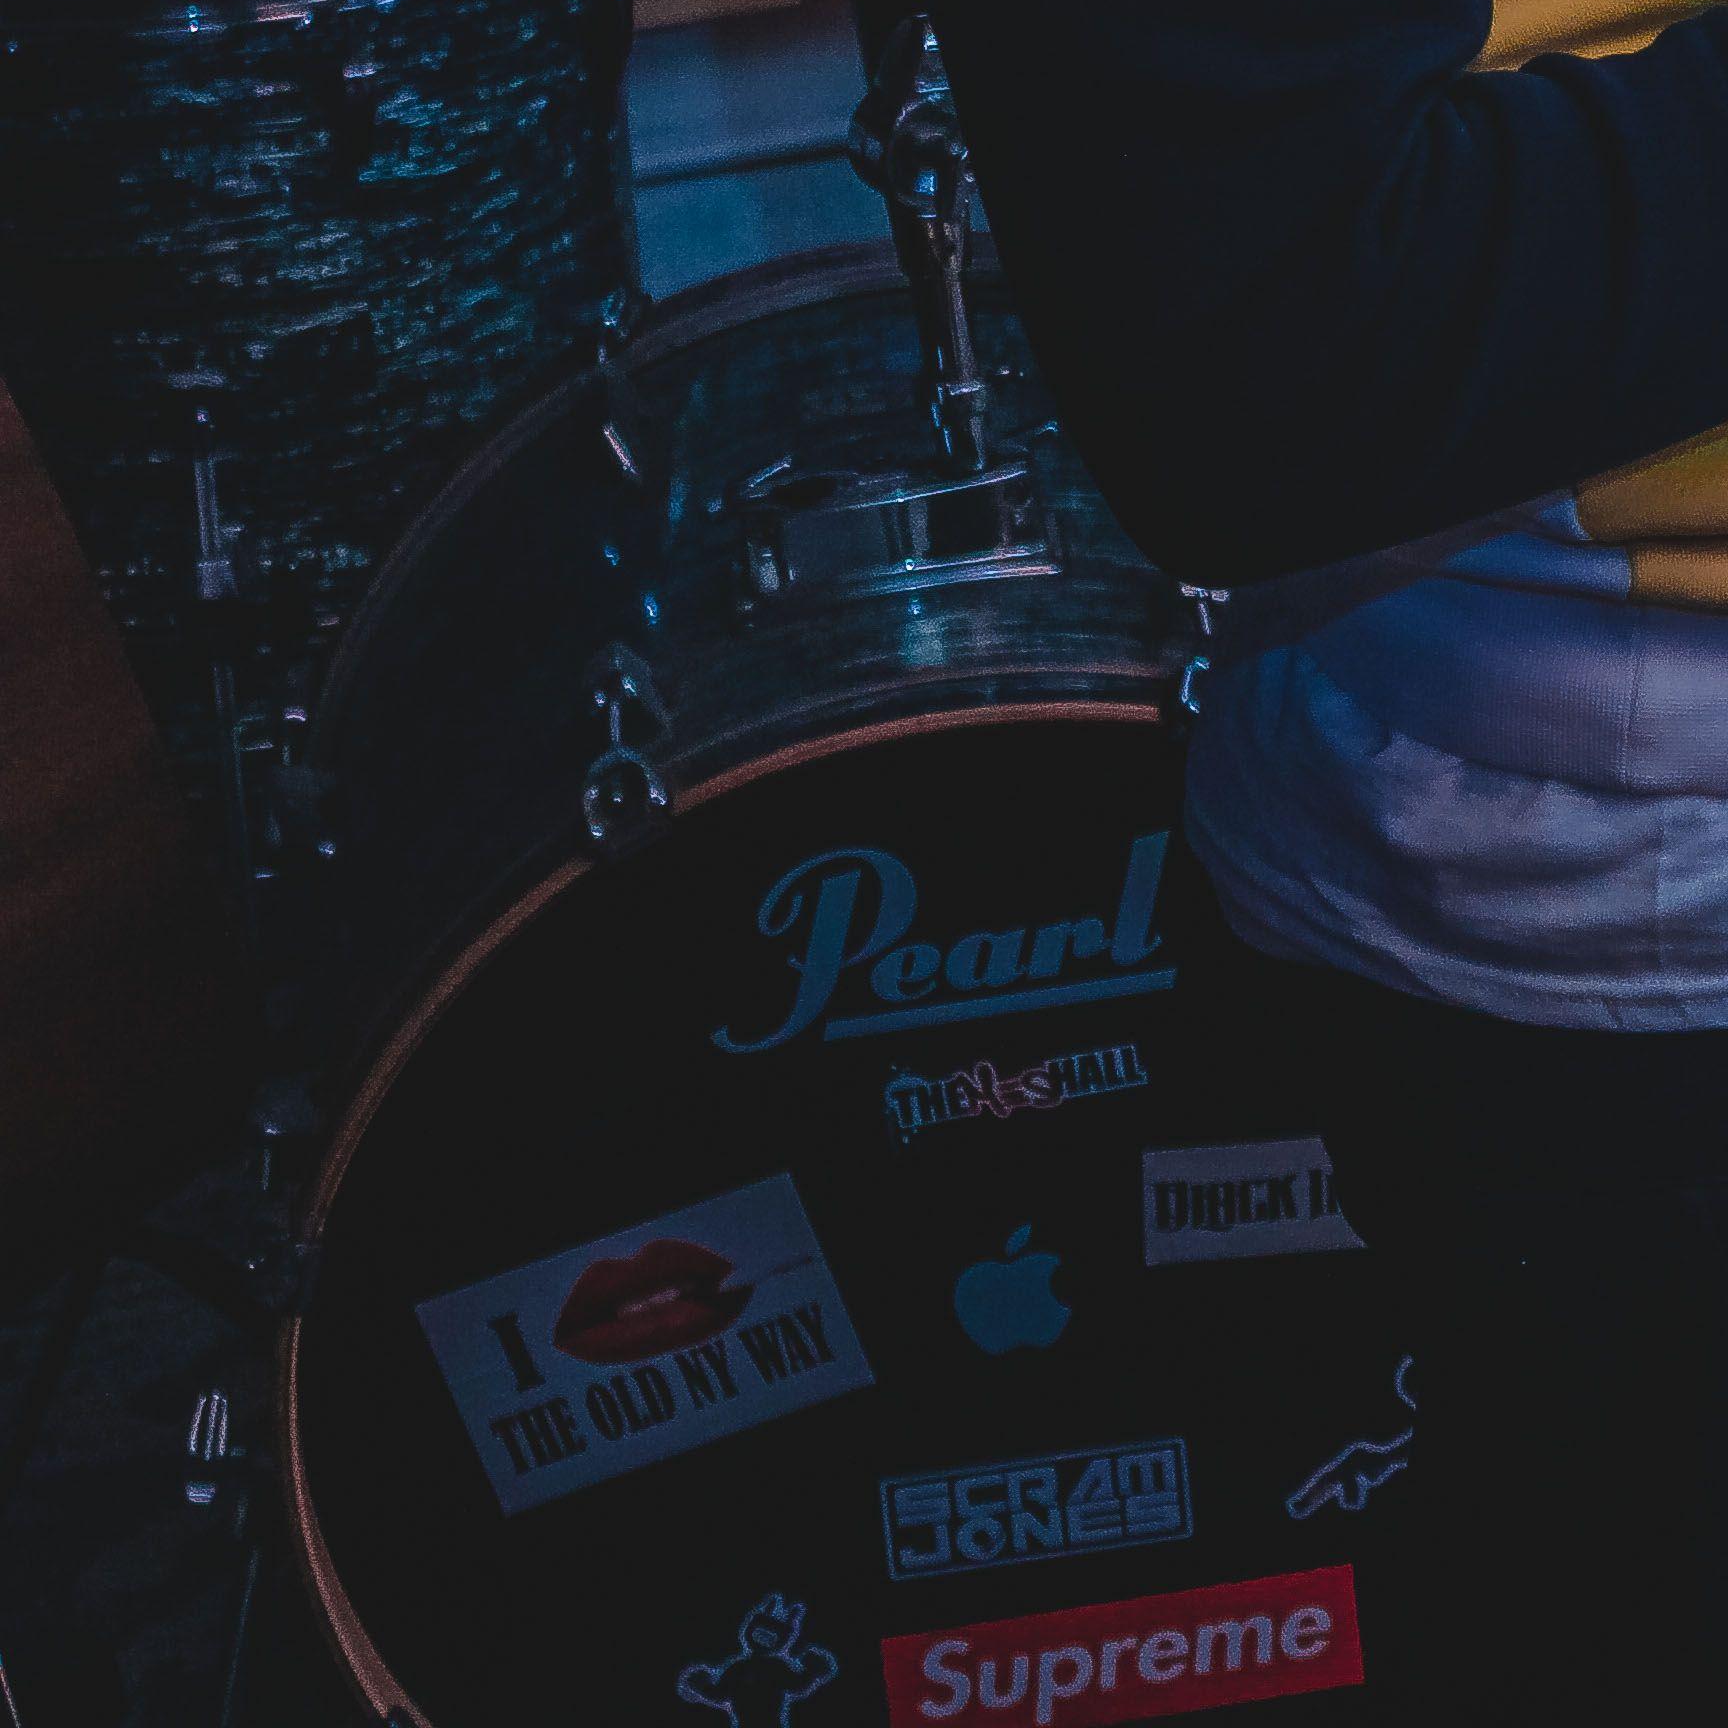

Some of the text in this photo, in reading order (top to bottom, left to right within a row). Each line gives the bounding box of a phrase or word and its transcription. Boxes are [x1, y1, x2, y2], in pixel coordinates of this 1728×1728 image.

[711, 830, 1169, 1054] Pearl
[489, 1312, 547, 1393] I
[490, 1301, 834, 1476] THE OLD NY WAY
[894, 1449, 1178, 1527] SCRAM
[898, 1493, 1182, 1569] JONES
[917, 1603, 1335, 1727] Supreme
